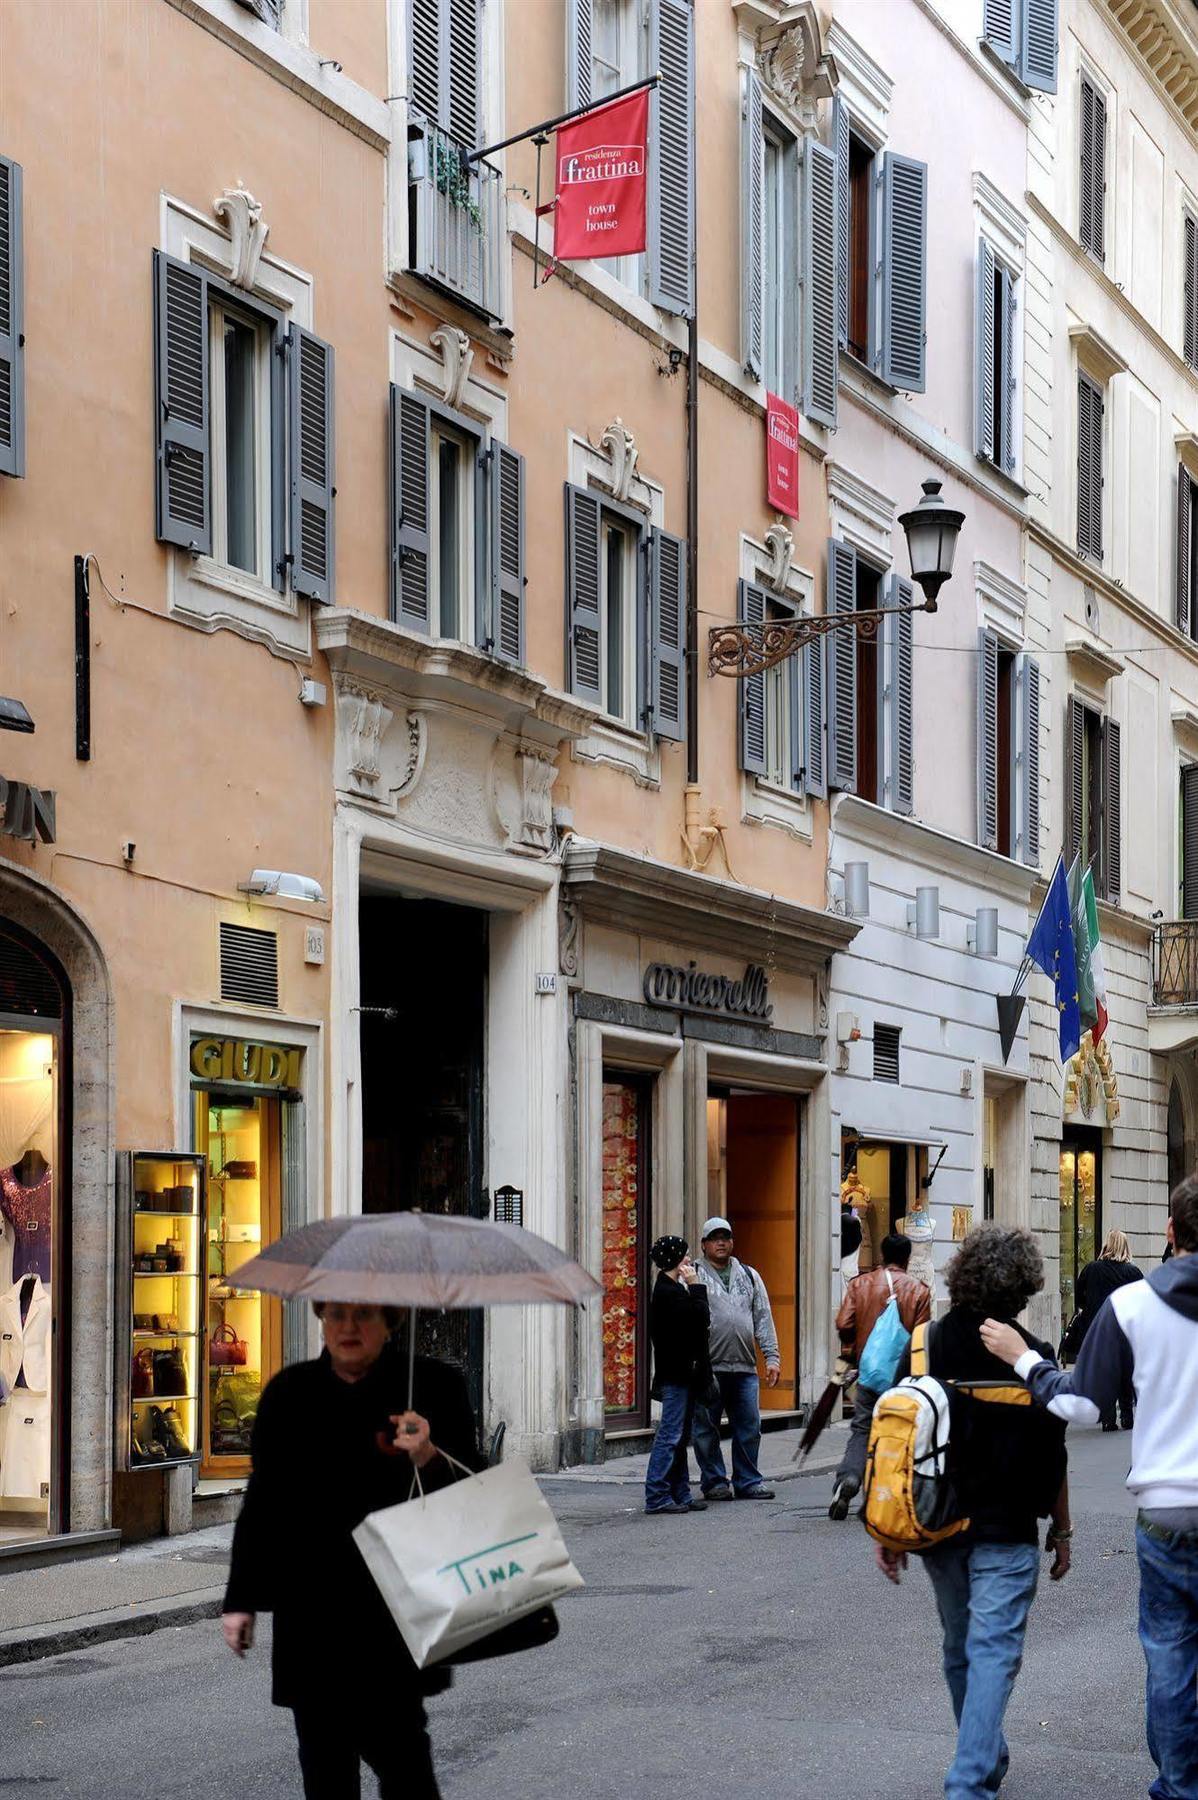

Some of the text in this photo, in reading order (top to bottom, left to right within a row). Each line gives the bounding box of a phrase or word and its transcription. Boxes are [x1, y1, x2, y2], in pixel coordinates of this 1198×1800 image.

[584, 149, 622, 162] residenza
[566, 157, 640, 184] frattina
[588, 202, 616, 216] town
[586, 218, 618, 232] house
[307, 936, 322, 954] 103
[538, 975, 555, 990] 104
[190, 1037, 301, 1089] GIUDI
